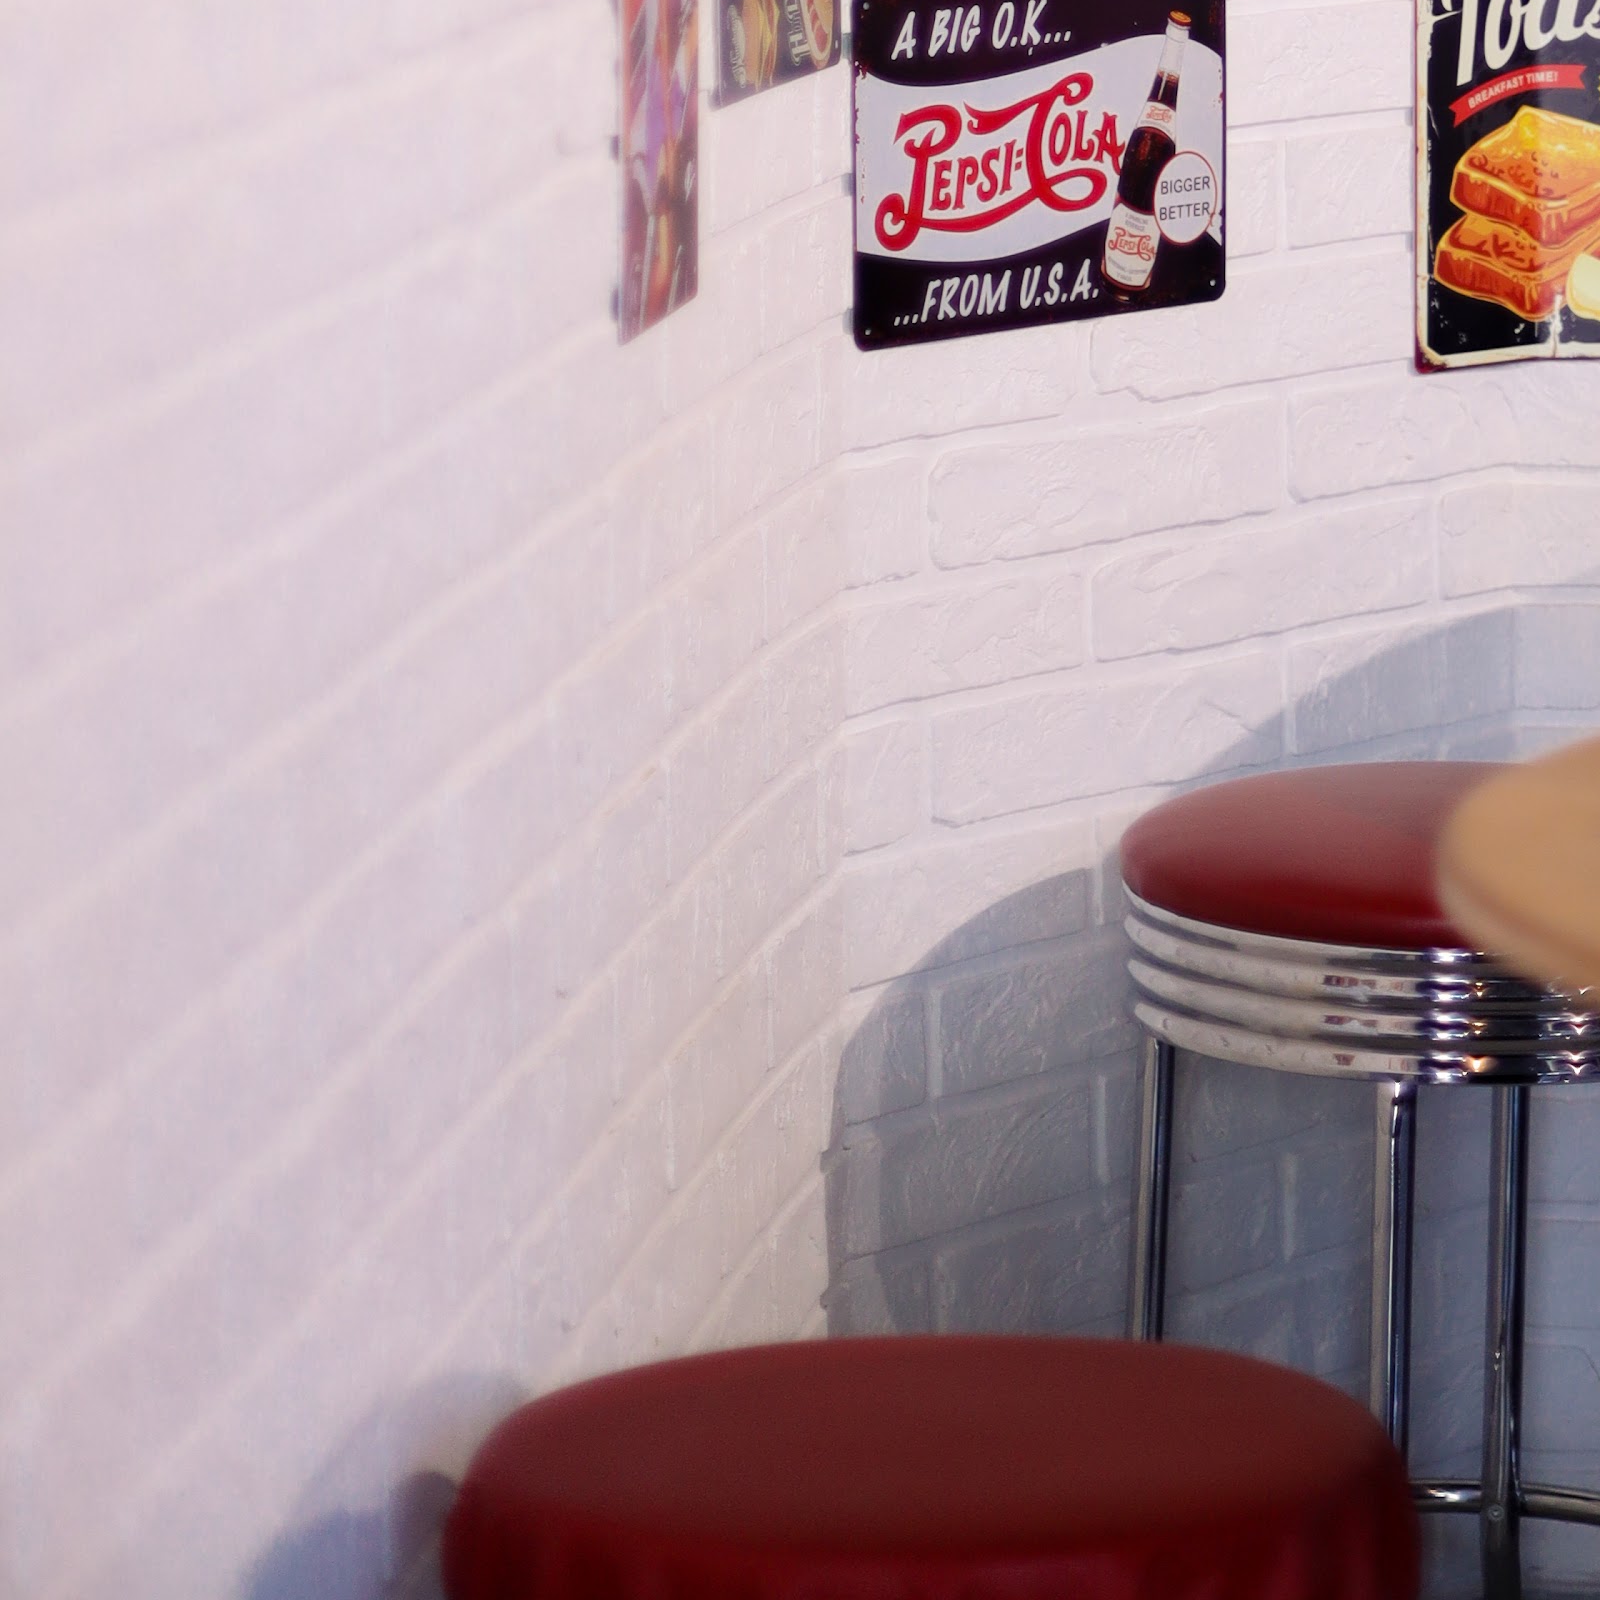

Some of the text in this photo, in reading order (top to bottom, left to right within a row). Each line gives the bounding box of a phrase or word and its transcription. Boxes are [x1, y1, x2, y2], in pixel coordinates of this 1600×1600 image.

[890, 11, 917, 60] A
[928, 5, 981, 57] BIG
[1467, 70, 1560, 110] BREAKFAST TIME!
[1160, 175, 1211, 195] BIGGER
[1159, 201, 1212, 221] BETTER
[1020, 258, 1099, 309] U.S.A.
